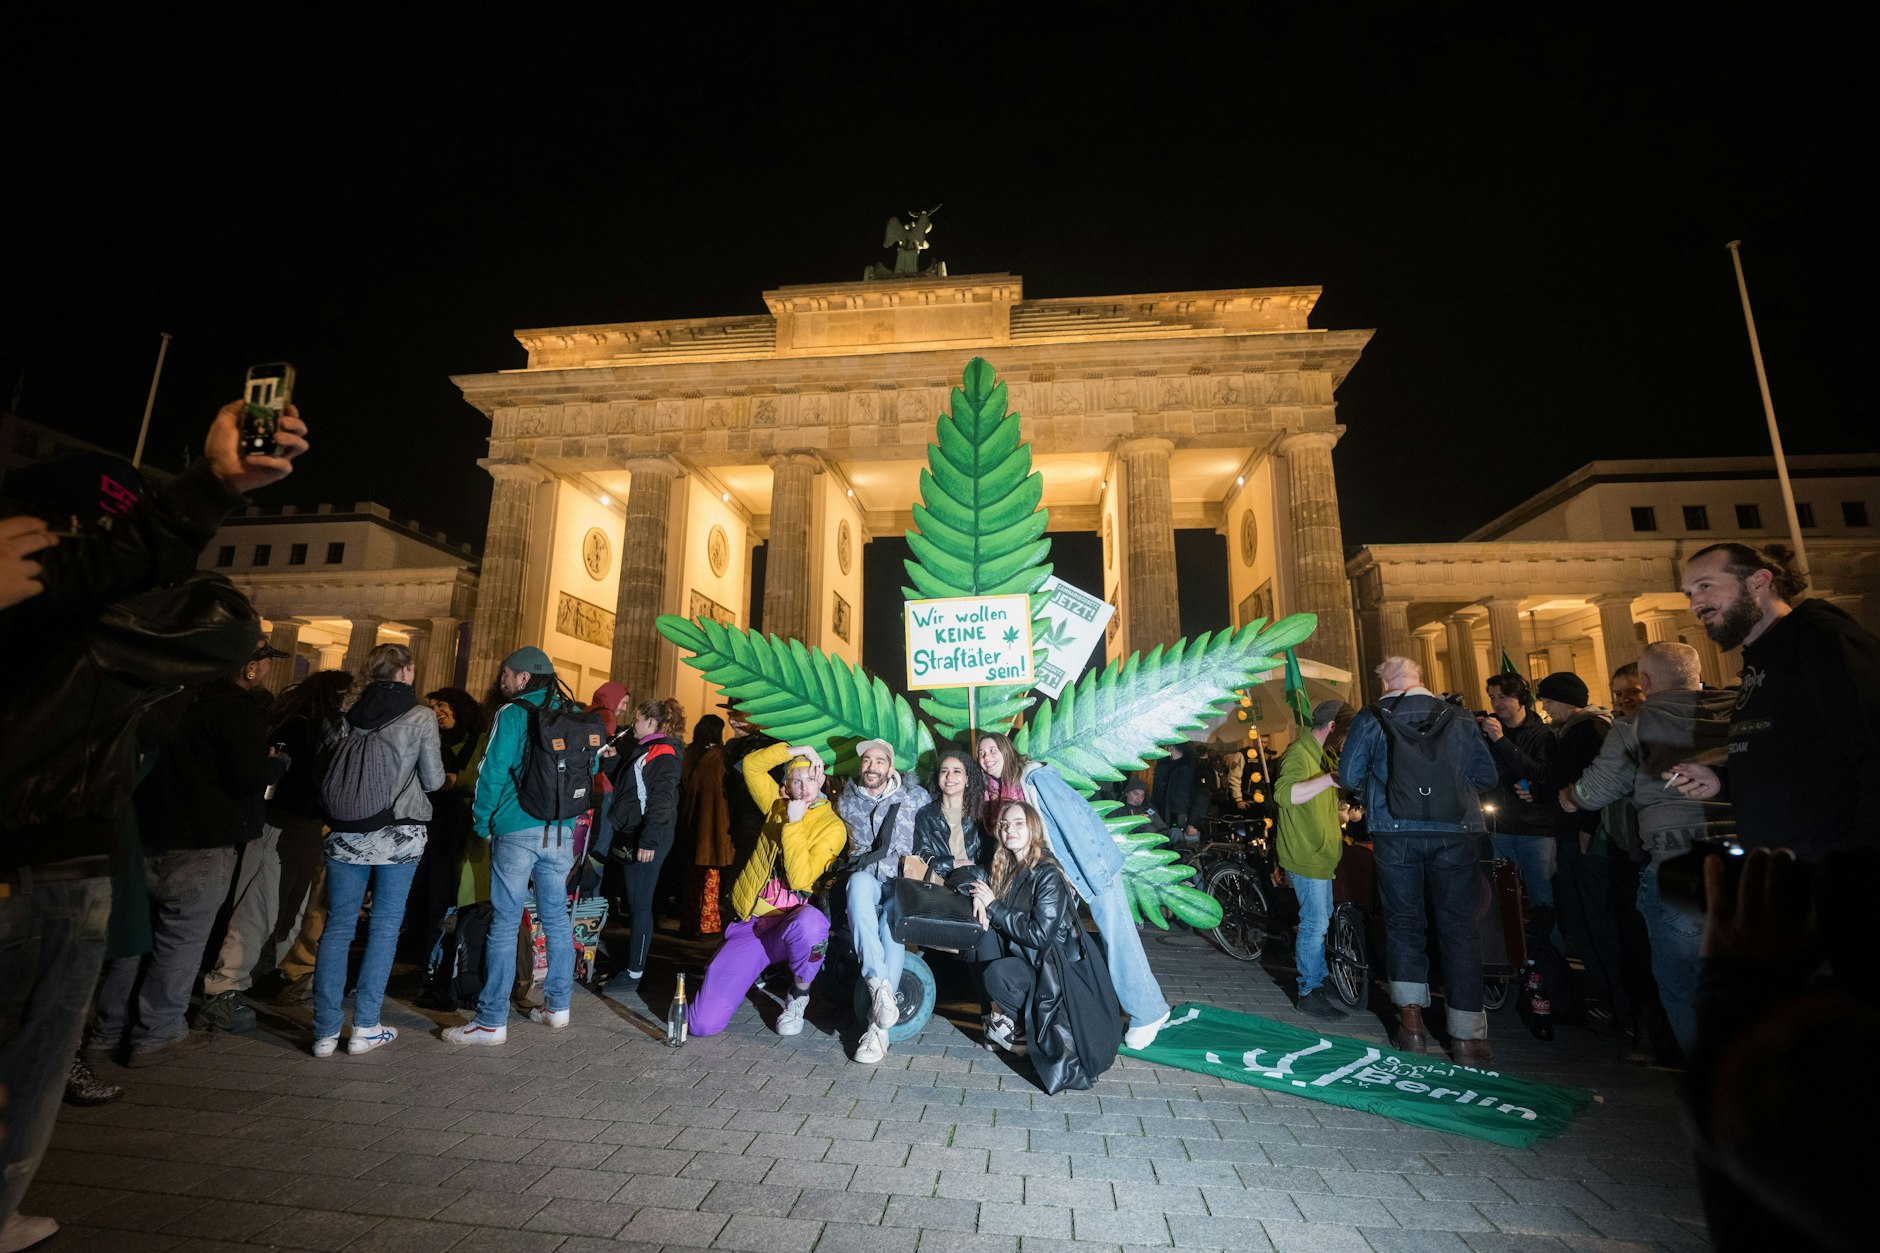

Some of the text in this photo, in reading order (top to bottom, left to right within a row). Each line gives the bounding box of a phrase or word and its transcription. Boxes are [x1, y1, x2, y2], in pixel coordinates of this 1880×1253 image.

[912, 605, 1007, 628] Wir wollen
[1051, 592, 1097, 620] JETZT!
[935, 626, 986, 644] KEINE
[913, 647, 1002, 676] Straftäter
[985, 655, 1025, 681] sein!
[1351, 1067, 1538, 1121] Berlin
